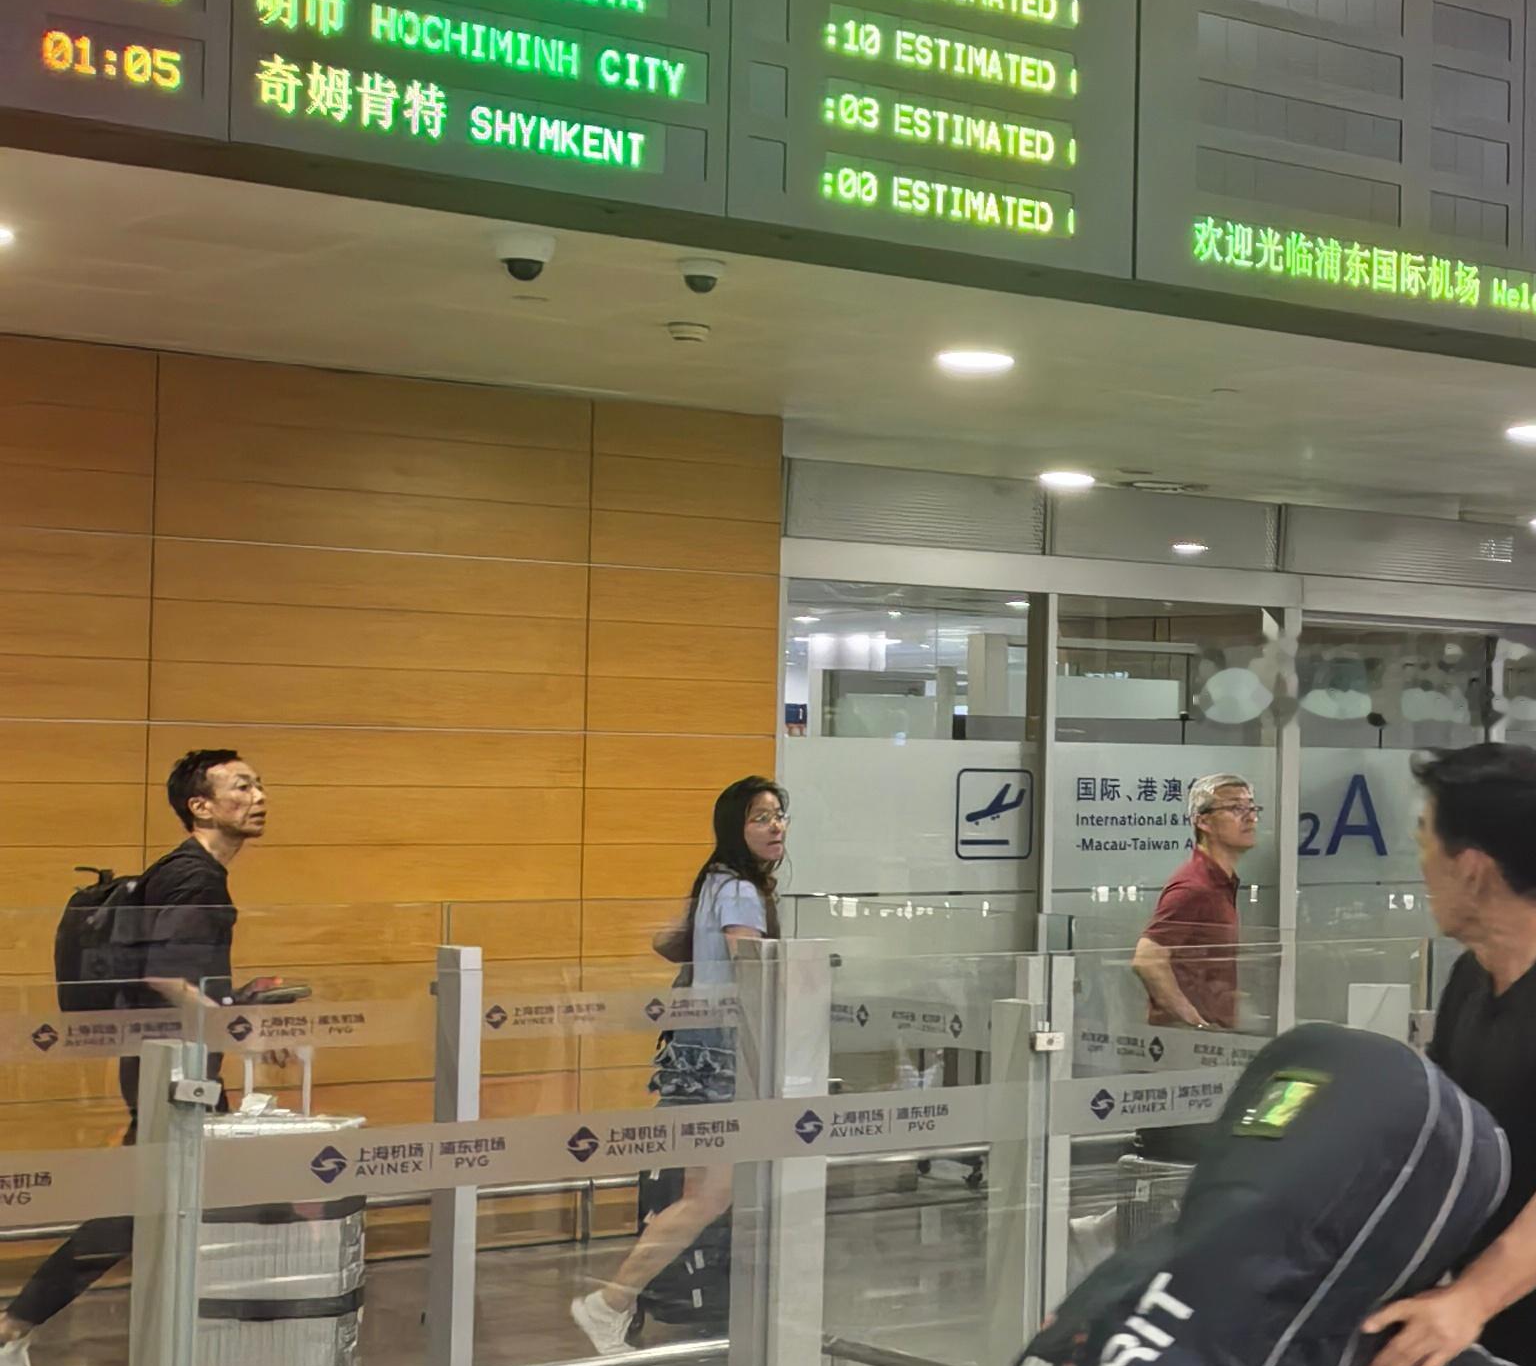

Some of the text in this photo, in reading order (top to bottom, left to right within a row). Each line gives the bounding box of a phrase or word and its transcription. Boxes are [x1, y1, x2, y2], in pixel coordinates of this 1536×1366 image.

[42, 30, 181, 89] 01:05
[372, 4, 580, 77] HOCHIMINH
[600, 48, 686, 98] CITY
[895, 31, 1055, 93] ESTIMATED
[255, 54, 645, 167] 奇姆肯特 SHYMKENT
[894, 103, 1054, 164] ESTIMATED
[893, 177, 1053, 235] ESTIMATED
[1192, 216, 1480, 308] 欢迎光临浦东国际机场
[1076, 777, 1196, 802] 国际、港澳
[1076, 812, 1179, 827] International &
[1076, 838, 1179, 851] -Macau-Taiwan
[830, 1120, 936, 1138] AVINEX PVG
[356, 1142, 424, 1162] 上海机场
[606, 1136, 725, 1156] AVINEX PVG
[355, 1155, 490, 1177] AVINEX PVG
[0, 1191, 31, 1205] VG
